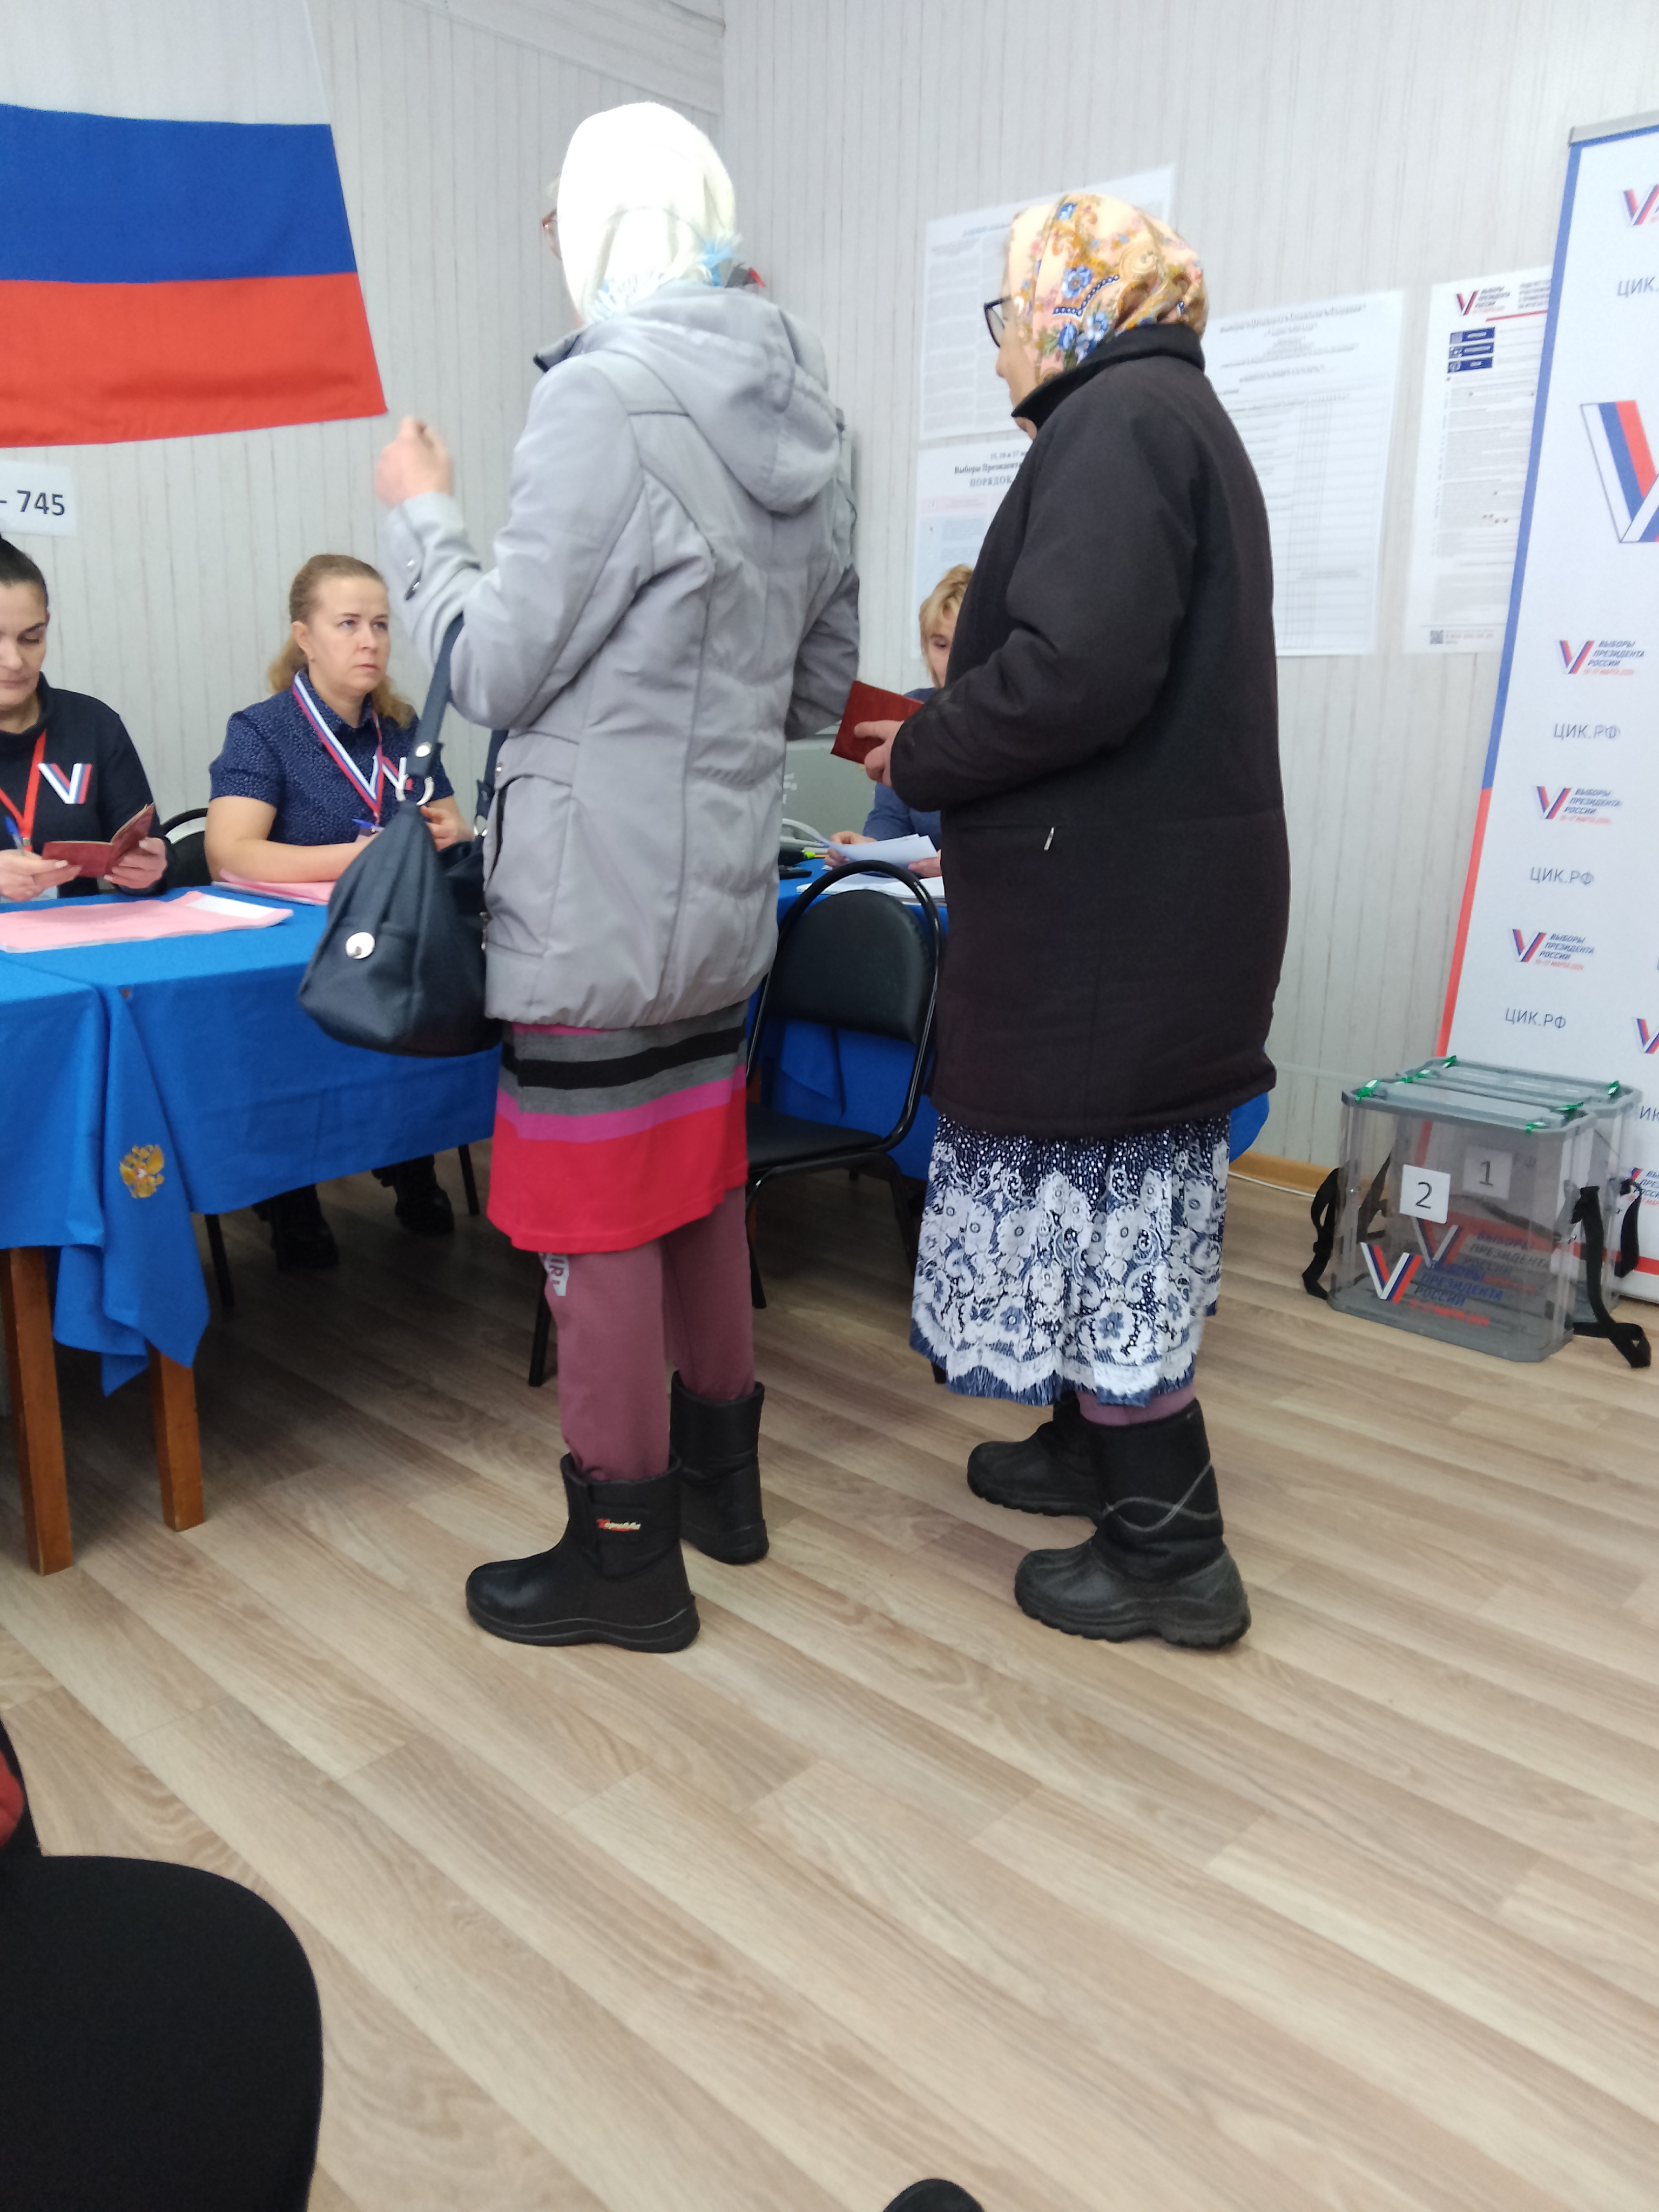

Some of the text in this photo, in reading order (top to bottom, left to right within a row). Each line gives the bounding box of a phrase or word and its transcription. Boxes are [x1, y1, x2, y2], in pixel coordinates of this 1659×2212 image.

[970, 475, 1013, 487] ПОРЯДОК
[17, 490, 65, 516] 745
[1599, 640, 1635, 648] ВЫБОРЫ
[1593, 650, 1644, 659] ПРЕЗИДЕНТА
[1554, 724, 1620, 740] ЦИК.РФ
[1575, 788, 1611, 797] ВЫБОРЫ
[1570, 797, 1622, 807] ПРЕЗИДЕНТА
[1564, 806, 1596, 814] РОССИИ
[1530, 866, 1594, 885] ЦИК.РФ
[1550, 933, 1586, 943] ВЫБОРЫ
[1545, 942, 1594, 954] ПРЕЗИДЕНТА
[1540, 950, 1571, 960] РОССИИ
[1505, 1008, 1566, 1028] ЦИК.РФ
[1479, 1160, 1494, 1186] 1
[1415, 1182, 1432, 1209] 2
[1420, 1273, 1503, 1301] ПРЕЗИДЕНТА
[1413, 1285, 1466, 1307] РОССИИ
